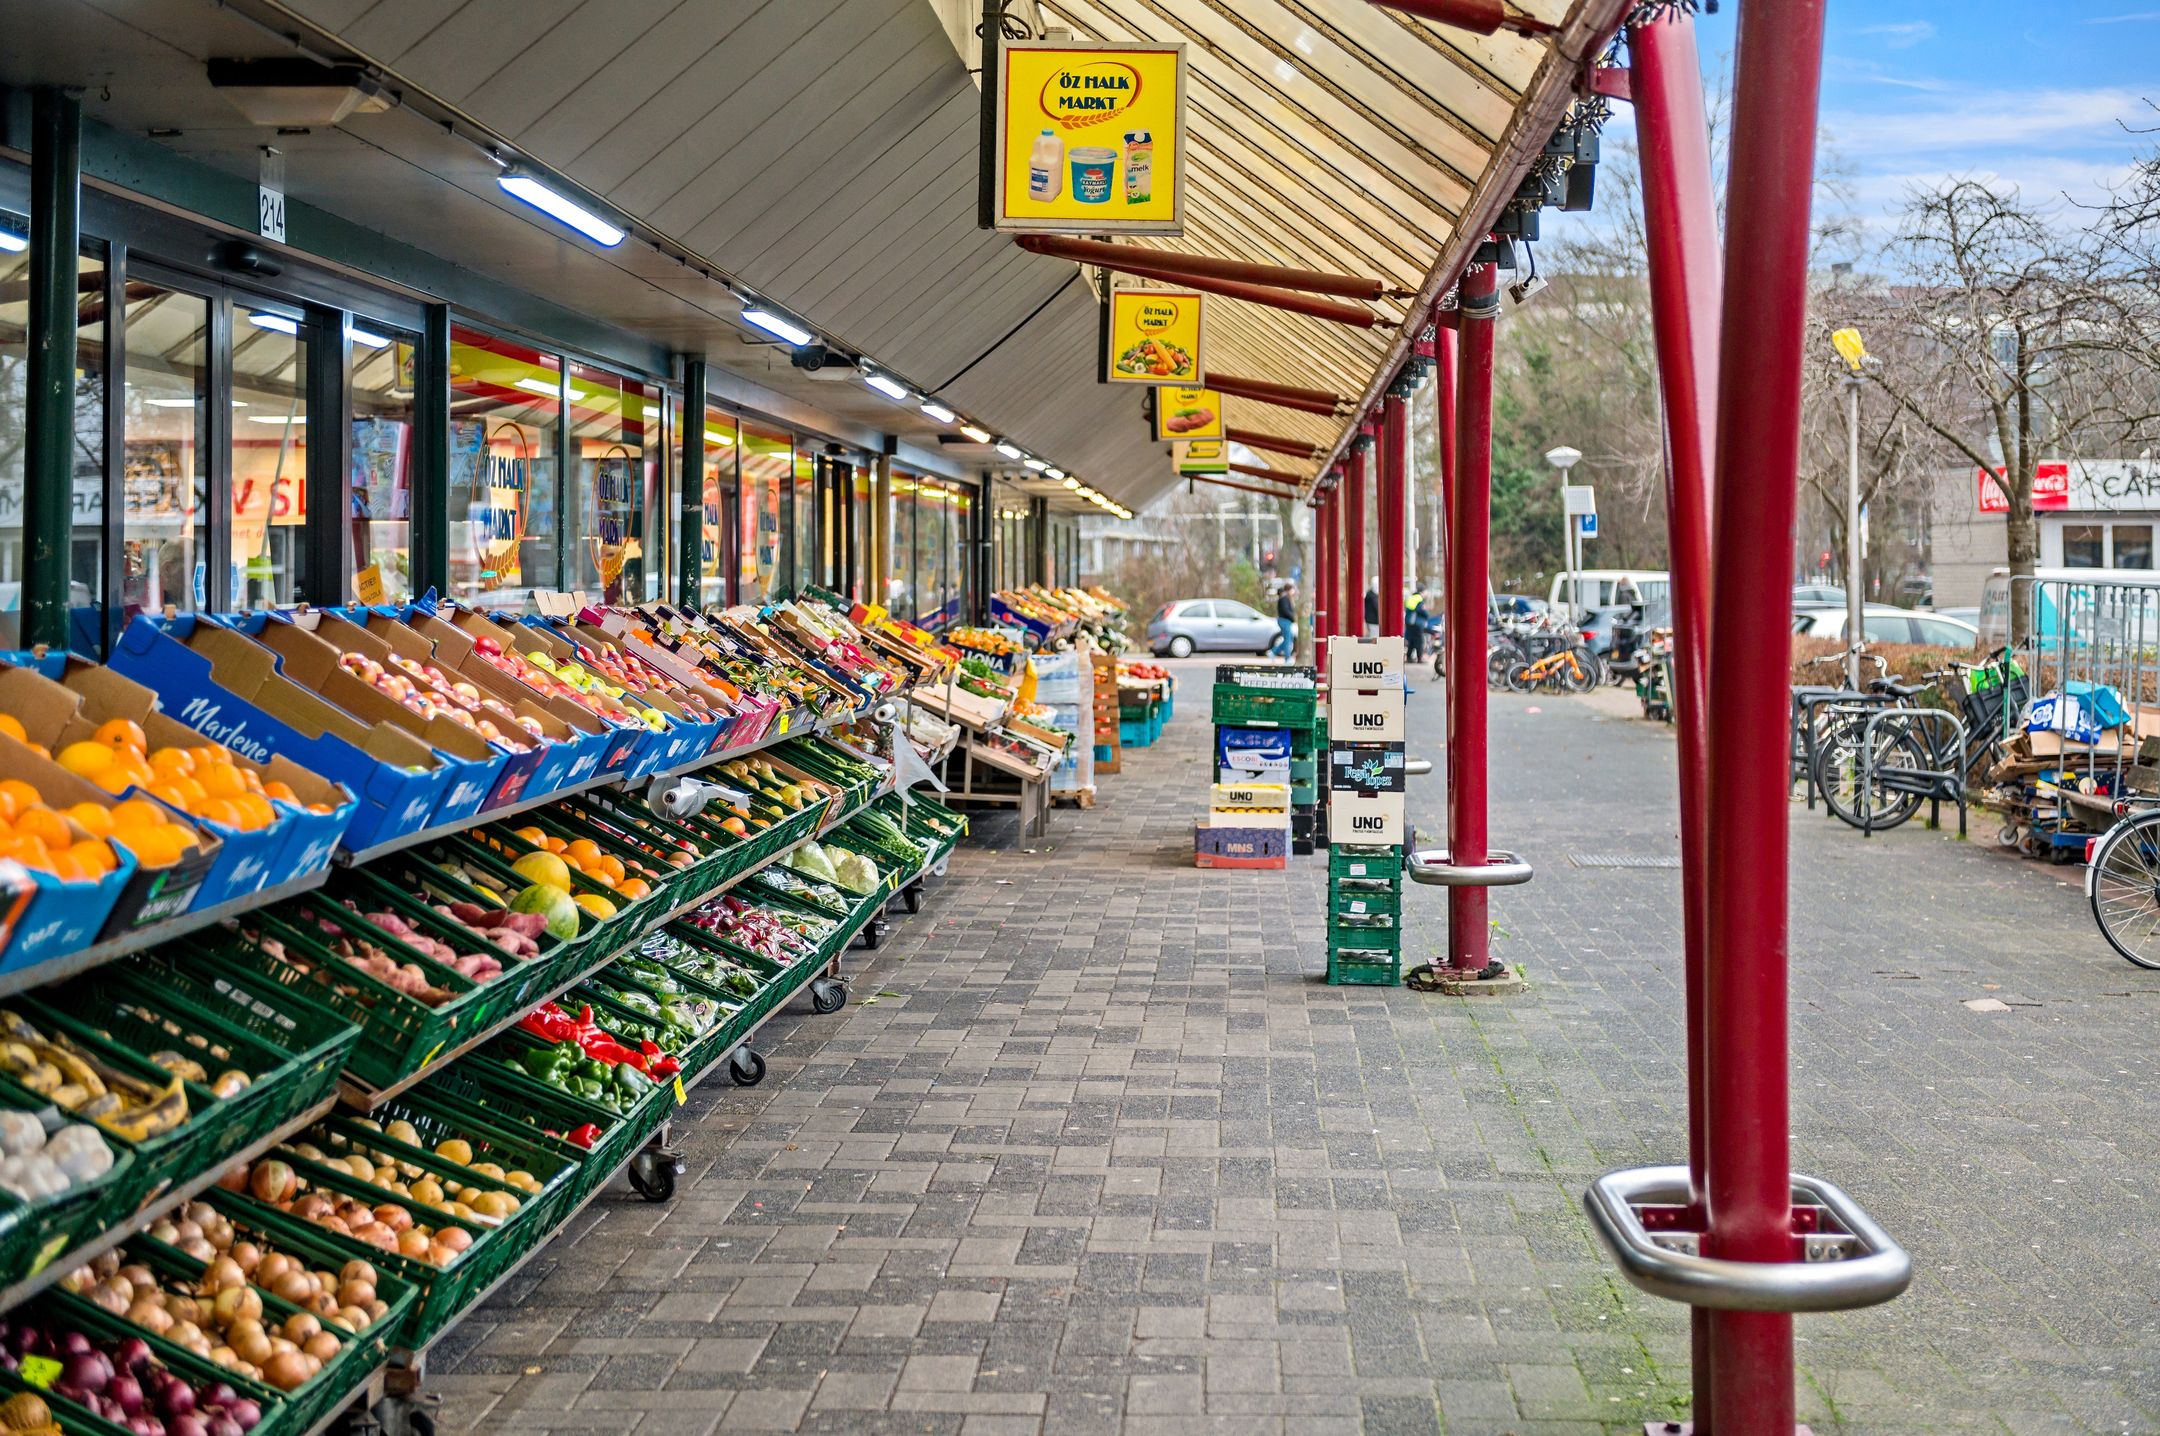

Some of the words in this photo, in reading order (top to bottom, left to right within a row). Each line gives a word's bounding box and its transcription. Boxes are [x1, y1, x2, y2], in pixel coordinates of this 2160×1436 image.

[1059, 72, 1080, 89] ÖZ
[1084, 76, 1129, 89] HALK
[1059, 96, 1117, 110] MARKT
[261, 194, 283, 236] 214
[1143, 319, 1167, 327] MARKT
[498, 456, 525, 492] HALK
[483, 508, 517, 540] MARKT
[1353, 662, 1383, 674] UNO
[1353, 714, 1384, 726] UNO
[181, 698, 268, 763] Marlene
[1229, 791, 1253, 801] UNO
[1353, 816, 1383, 829] UNO
[1227, 843, 1254, 853] MNS
